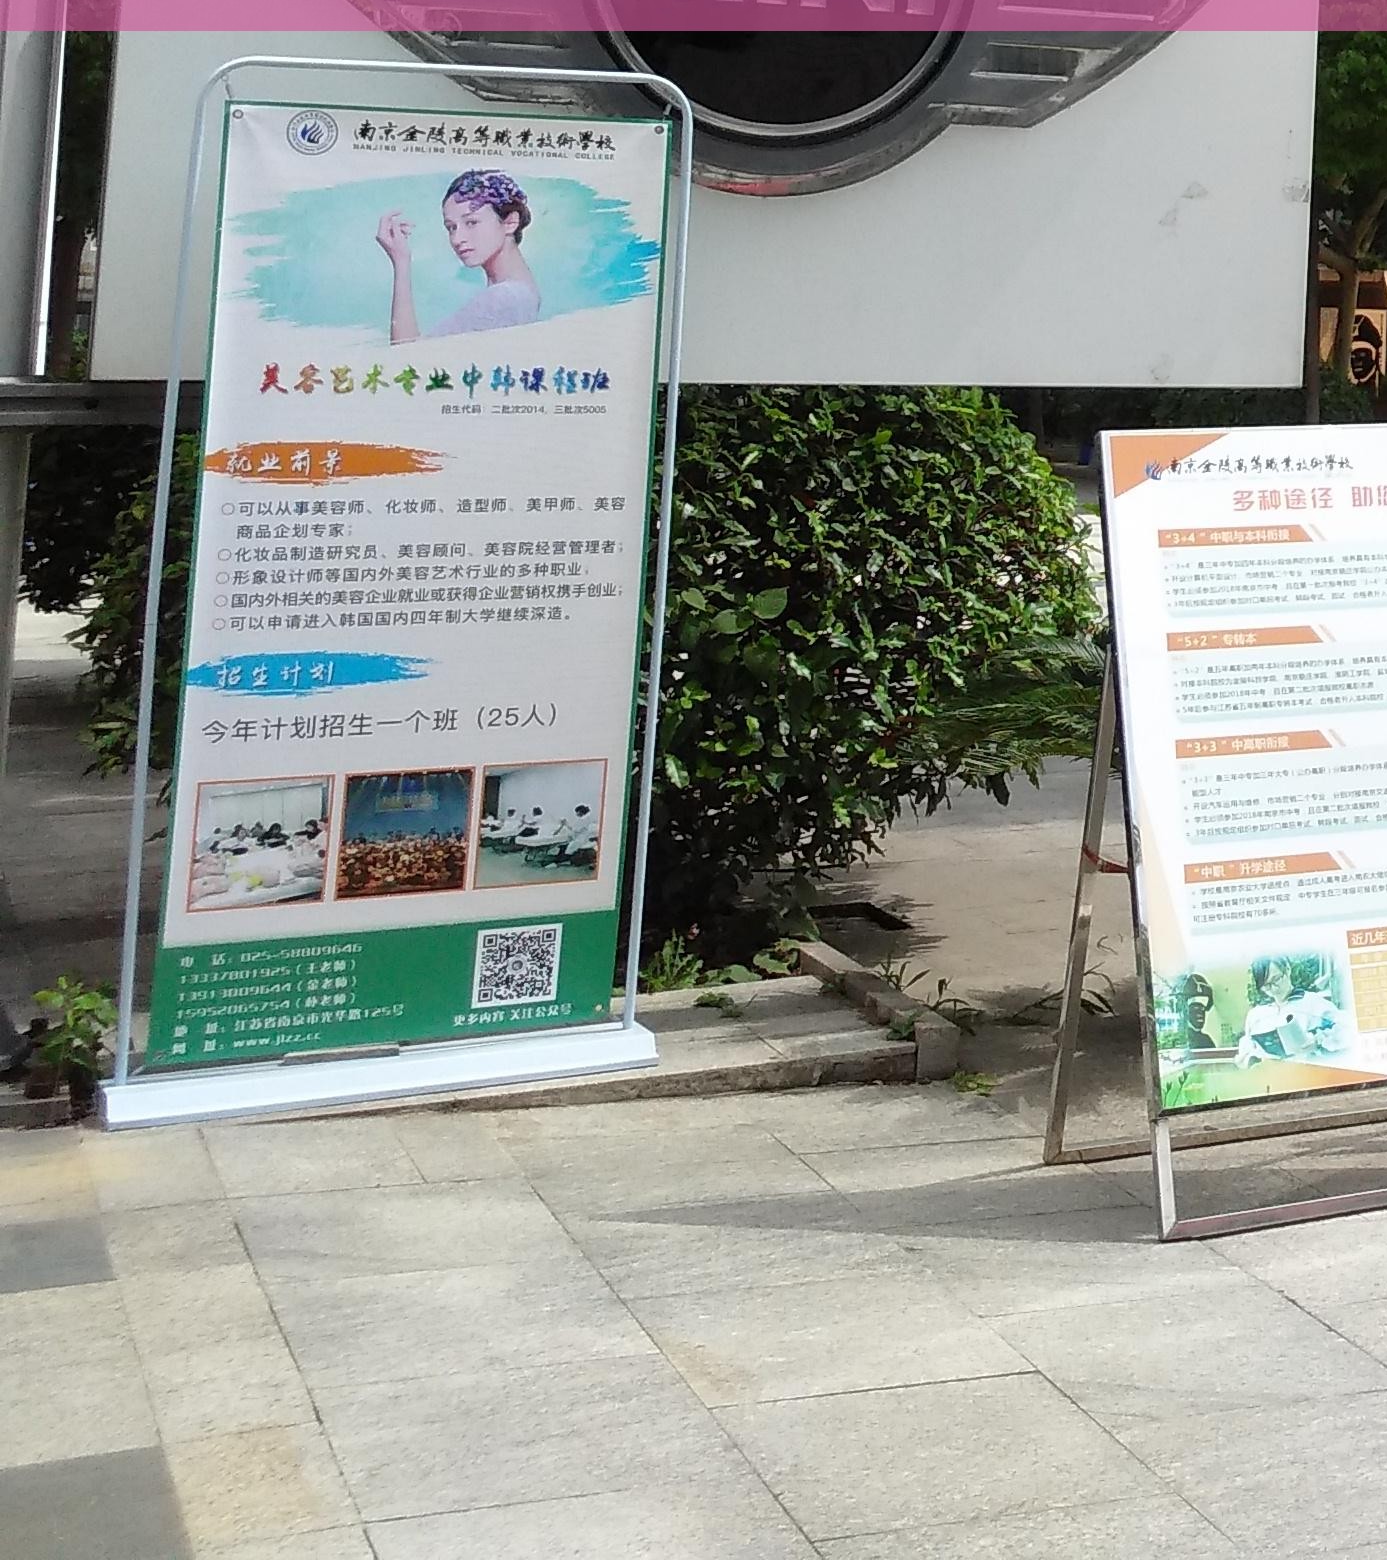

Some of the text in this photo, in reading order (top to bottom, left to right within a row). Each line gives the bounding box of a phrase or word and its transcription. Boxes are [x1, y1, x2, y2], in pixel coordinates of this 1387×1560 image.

[260, 362, 611, 399] 美容艺术专业中韩课程班
[226, 448, 343, 476] 就业前景
[1232, 487, 1334, 512] 多种途径
[217, 660, 336, 687] 招生计划
[201, 702, 558, 744] 今年计划招生一个班（25人）
